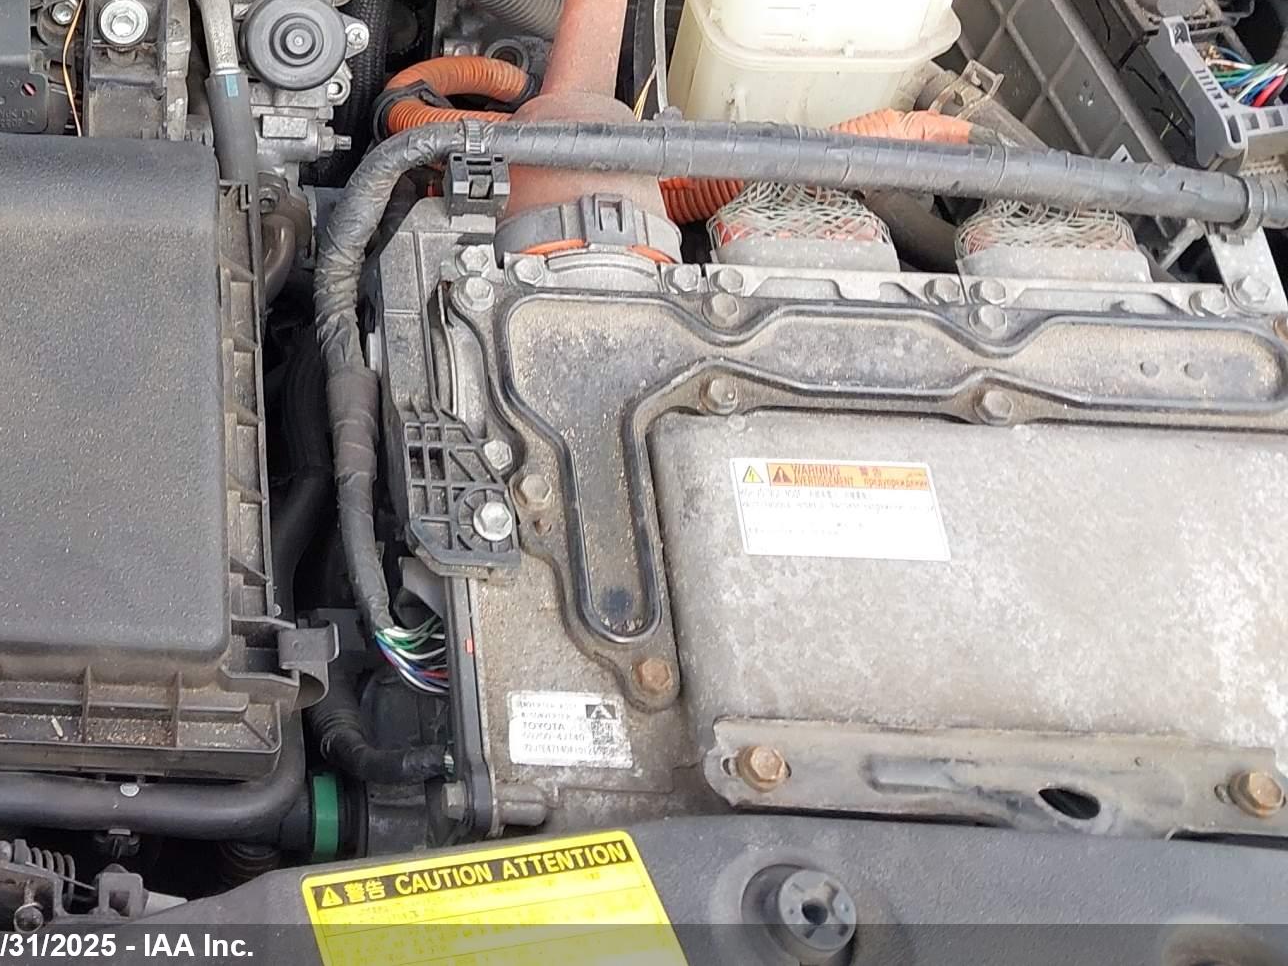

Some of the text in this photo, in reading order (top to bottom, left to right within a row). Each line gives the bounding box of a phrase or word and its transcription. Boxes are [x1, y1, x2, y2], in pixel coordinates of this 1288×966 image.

[791, 463, 842, 477] WARNING
[522, 721, 566, 731] TOYOTA
[395, 861, 494, 896] CAUTION
[502, 841, 628, 881] ATTENTION
